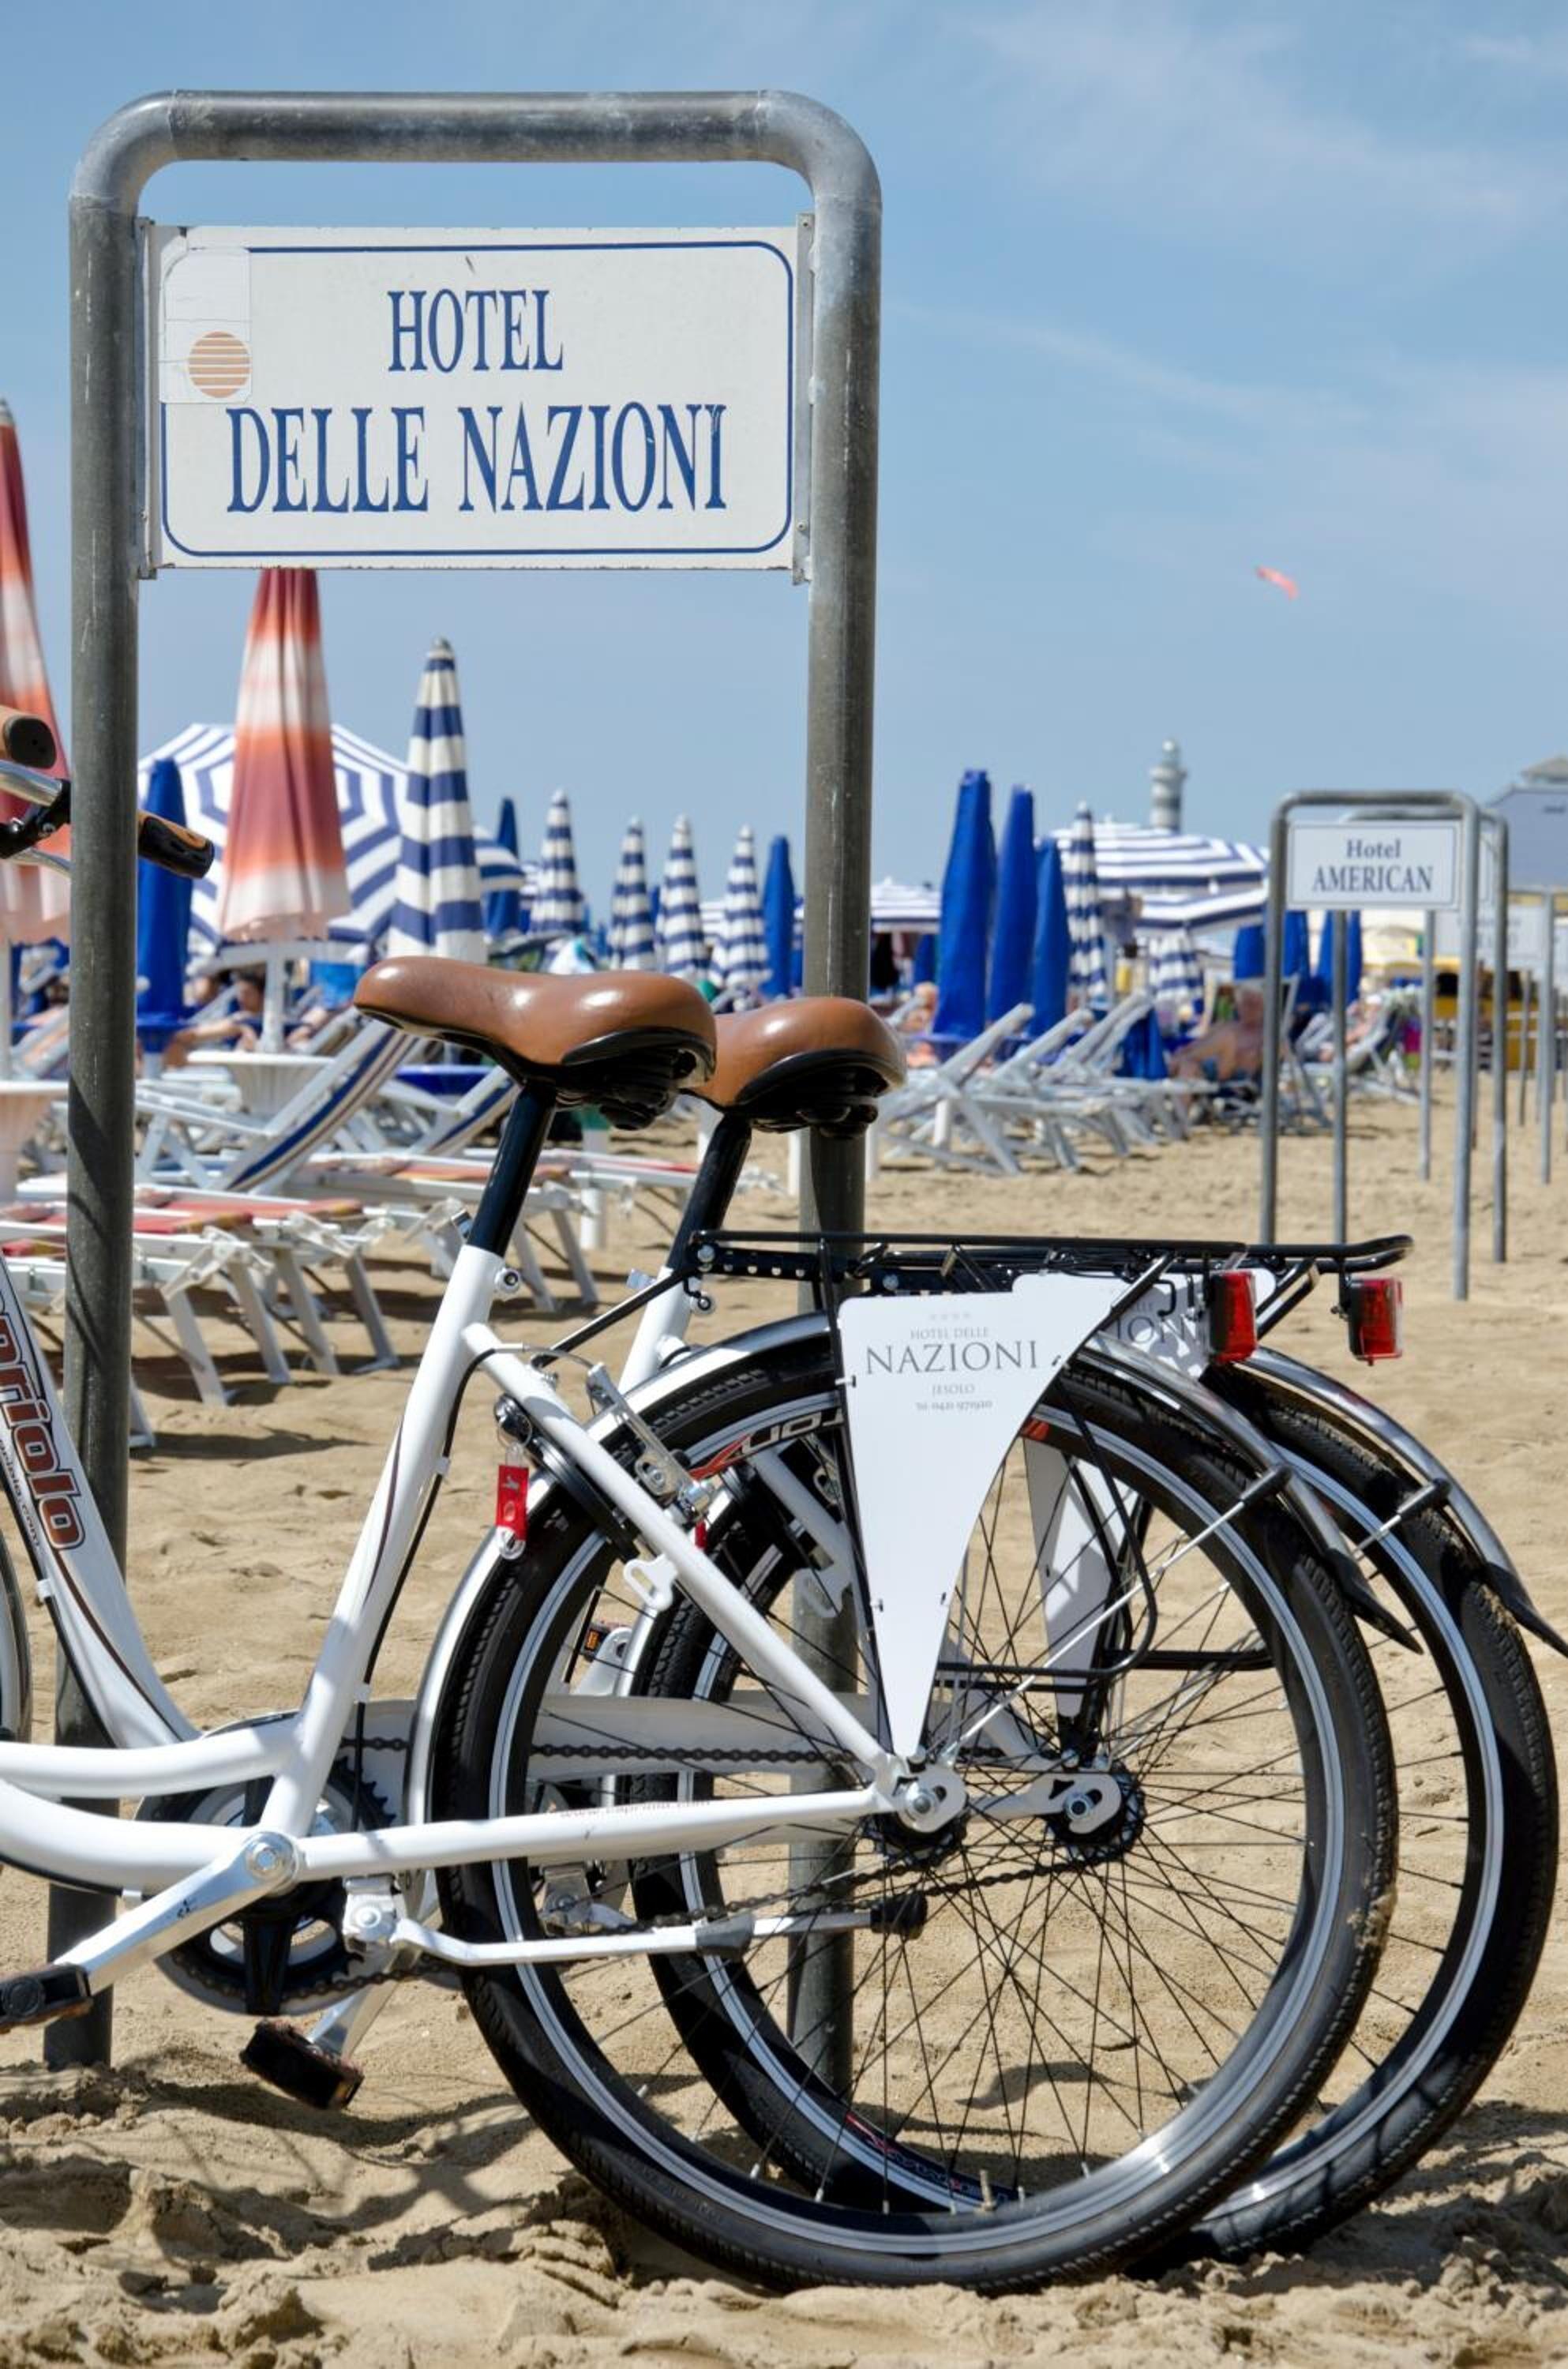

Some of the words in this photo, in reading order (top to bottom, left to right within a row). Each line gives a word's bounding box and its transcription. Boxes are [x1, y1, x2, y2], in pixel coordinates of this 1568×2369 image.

[387, 288, 563, 374] HOTEL
[225, 406, 429, 513] DELLE
[458, 402, 727, 512] NAZIONI
[1346, 839, 1401, 859] Hotel
[1312, 865, 1433, 893] AMERICAN
[866, 1340, 1038, 1375] NAZIONI
